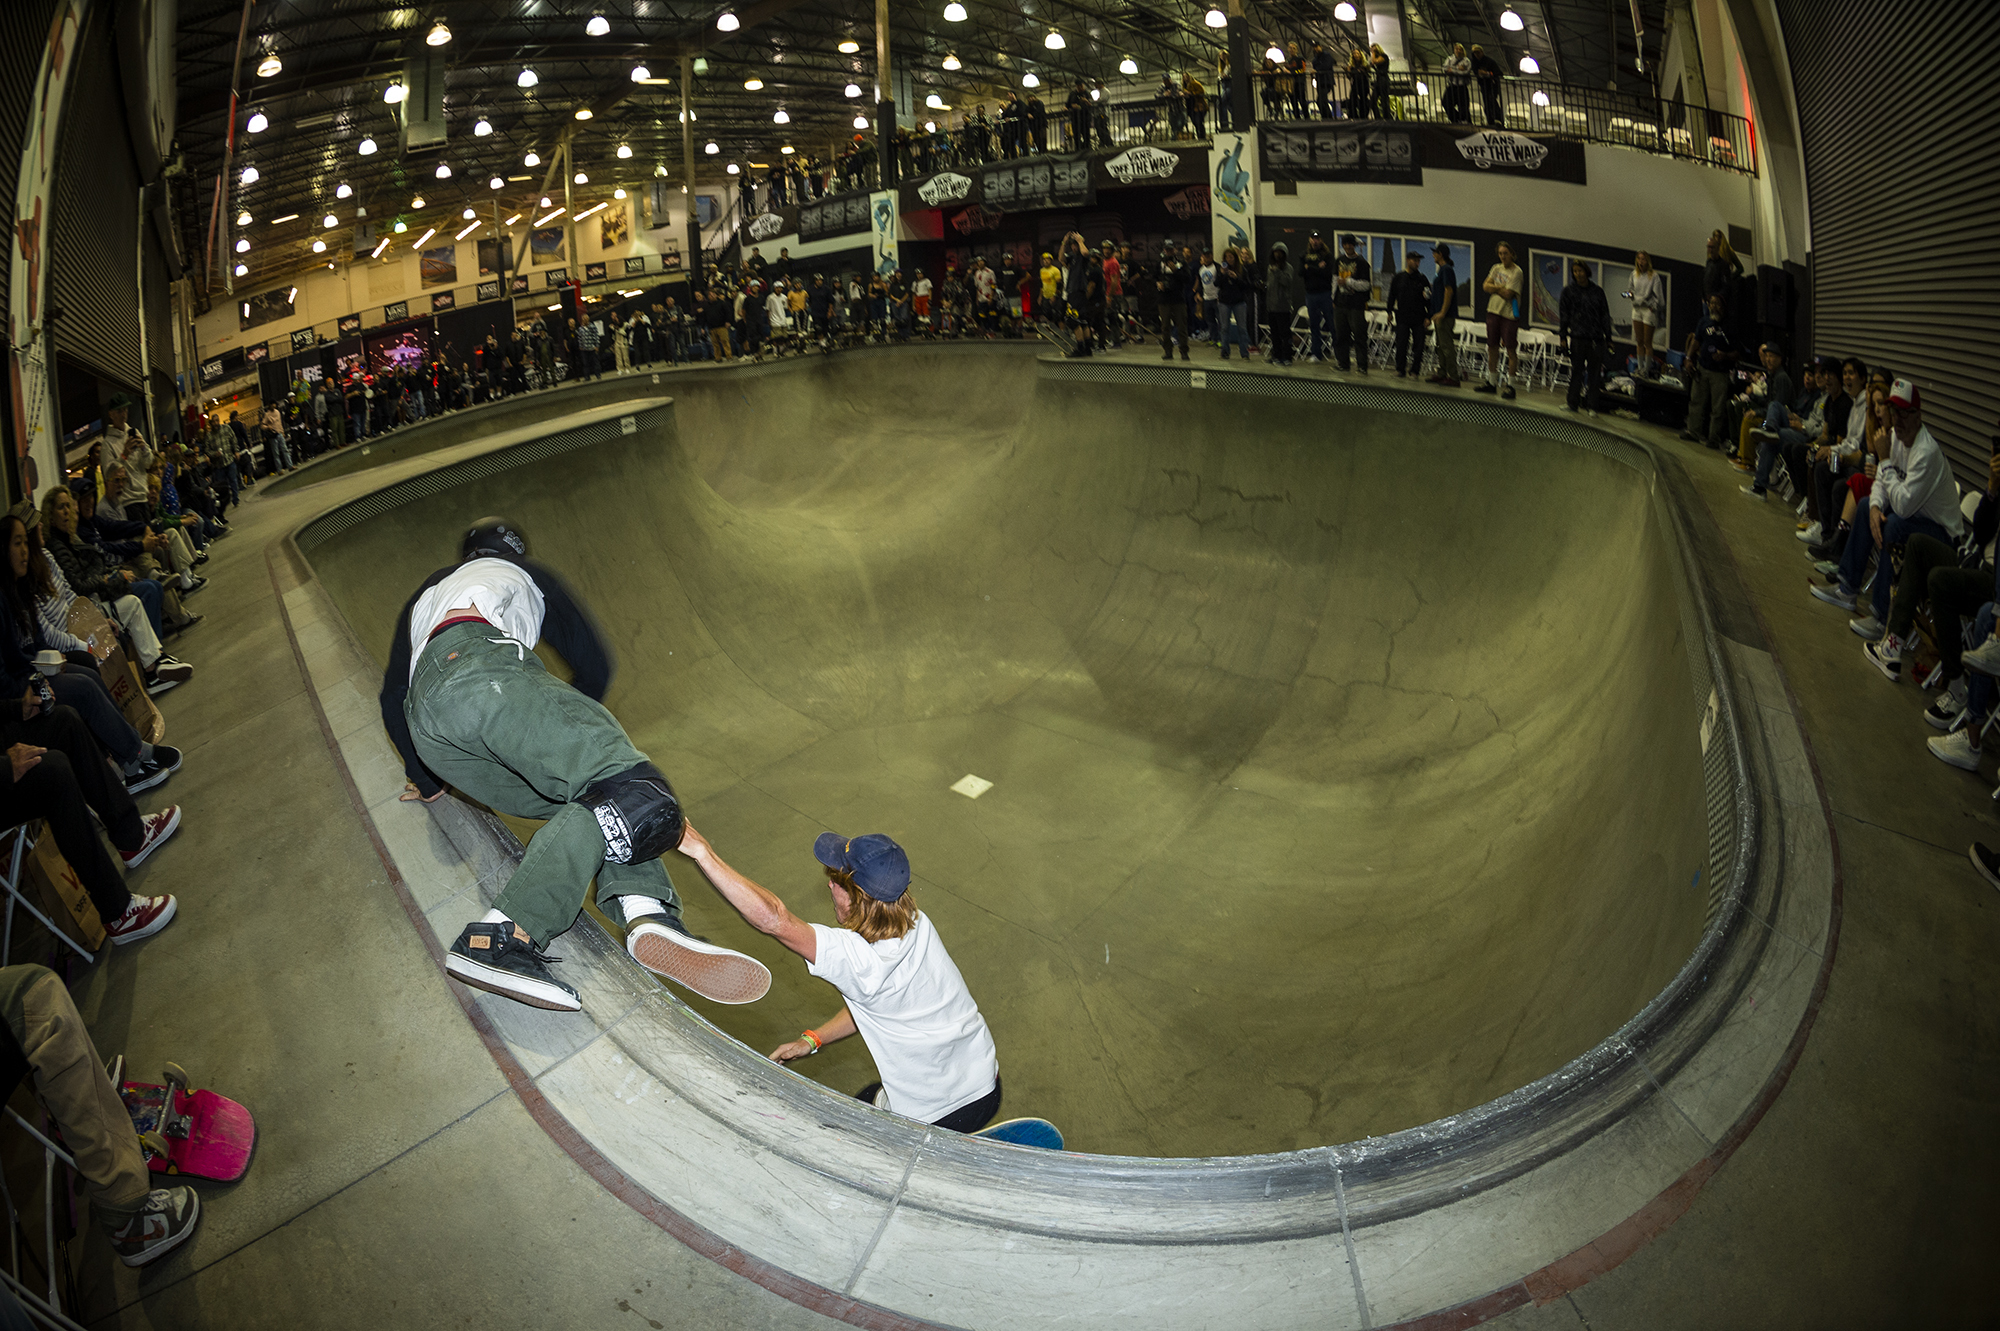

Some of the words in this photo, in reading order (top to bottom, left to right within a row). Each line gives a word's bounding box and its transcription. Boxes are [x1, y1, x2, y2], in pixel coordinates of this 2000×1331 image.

[1482, 133, 1515, 145] VANS
[1125, 149, 1153, 162] VANS
[1487, 145, 1512, 162] THE
[1131, 161, 1150, 175] THE
